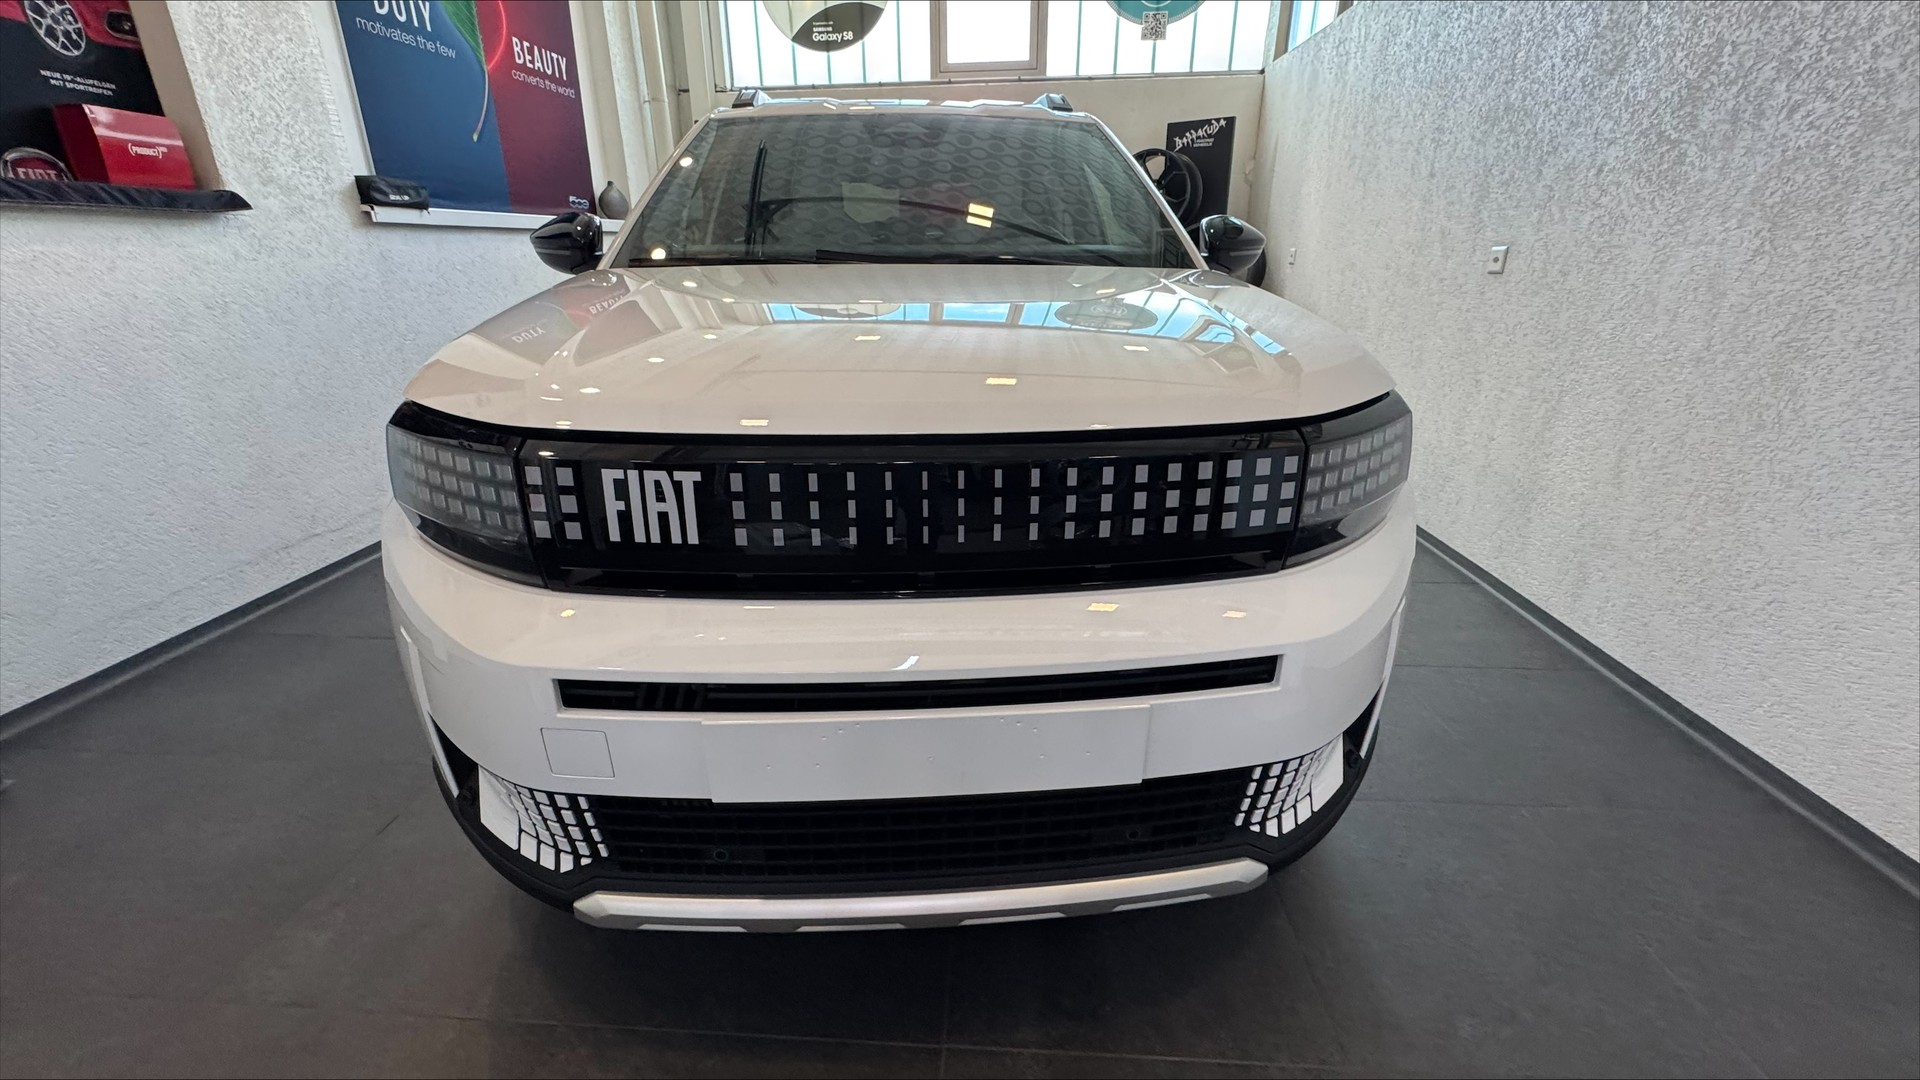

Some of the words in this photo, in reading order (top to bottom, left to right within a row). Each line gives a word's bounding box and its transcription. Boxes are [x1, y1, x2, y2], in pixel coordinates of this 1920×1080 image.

[356, 17, 416, 46] motivates
[417, 34, 435, 52] the
[436, 41, 456, 59] few
[812, 32, 842, 42] Galaxy
[843, 31, 853, 40] S8
[511, 36, 567, 81] BEAUTY
[511, 69, 545, 89] converts
[545, 79, 557, 93] the
[601, 468, 702, 545] FIAT
